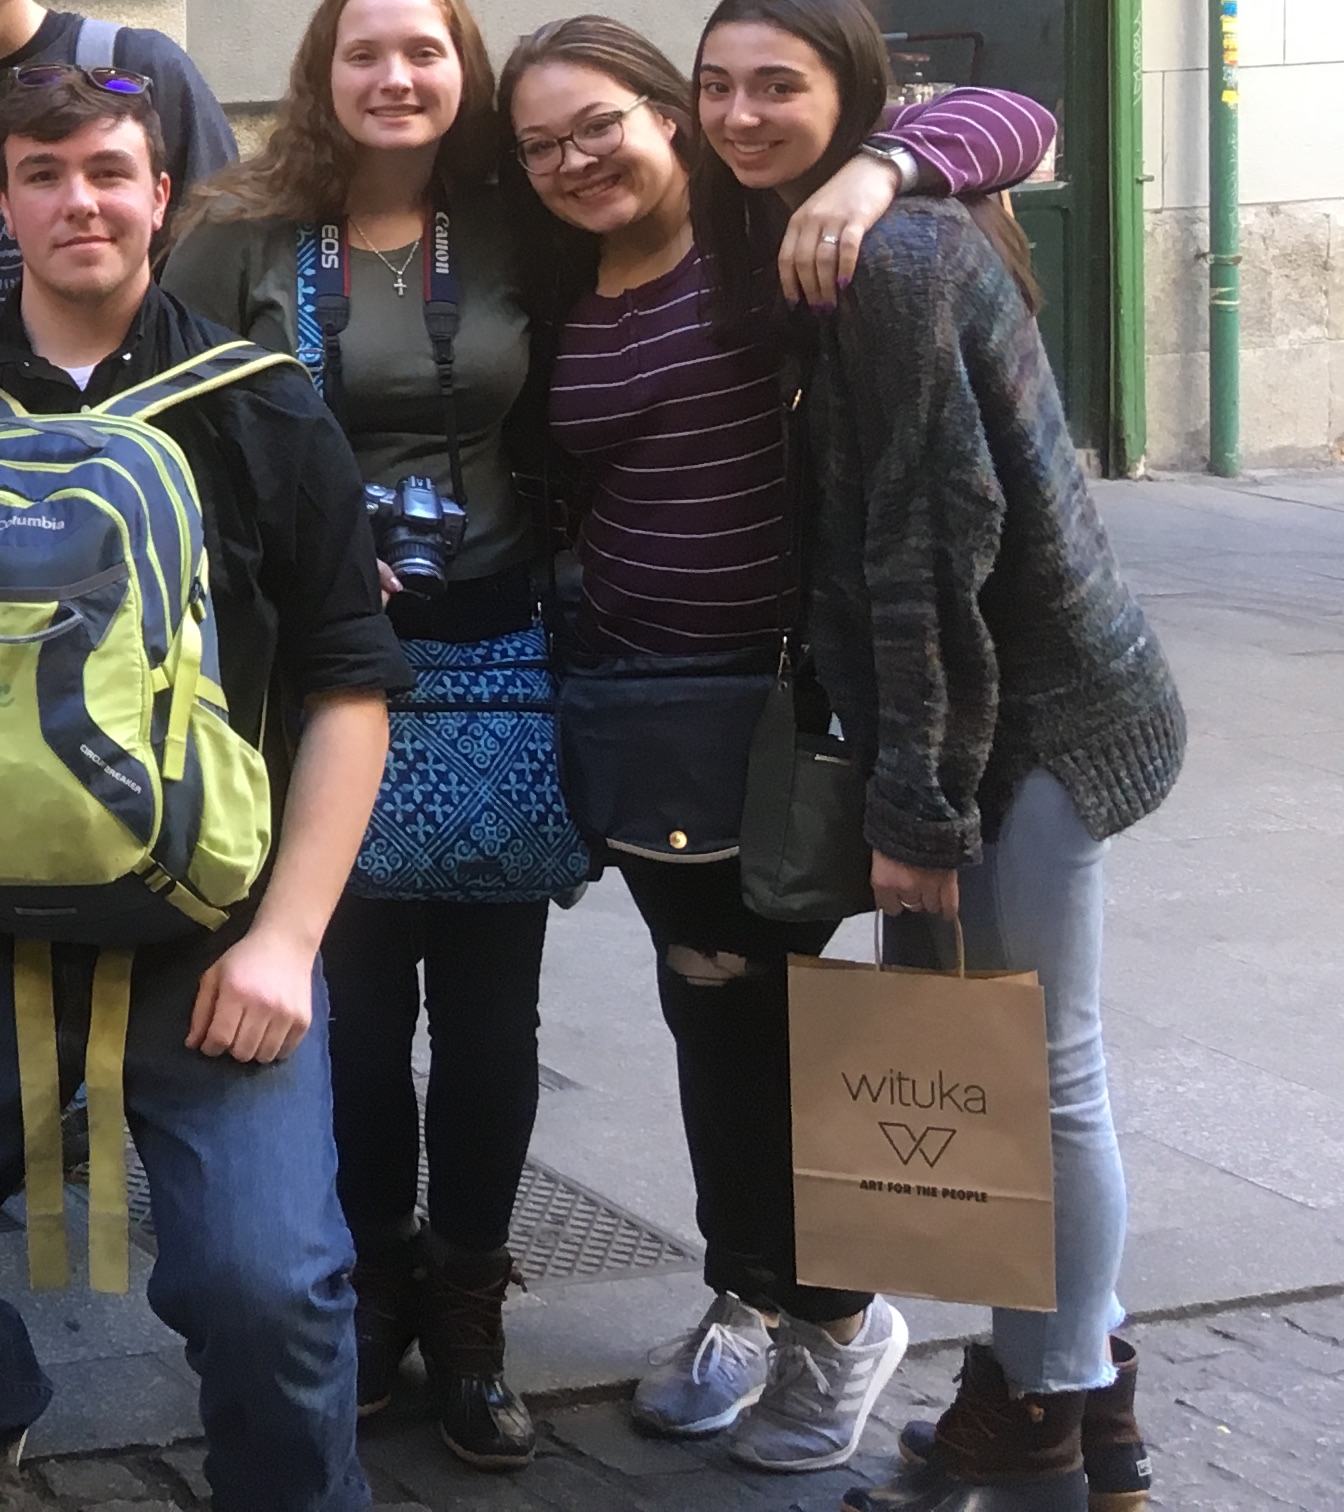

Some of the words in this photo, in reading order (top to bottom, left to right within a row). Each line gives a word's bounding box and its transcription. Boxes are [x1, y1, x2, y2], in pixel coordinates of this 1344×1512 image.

[321, 224, 339, 269] EOS
[435, 211, 451, 275] Canon
[841, 1068, 987, 1115] wituka
[859, 1179, 883, 1192] ART
[887, 1181, 913, 1195] FOR
[916, 1185, 938, 1198] THE
[941, 1188, 988, 1203] PEOPLE
